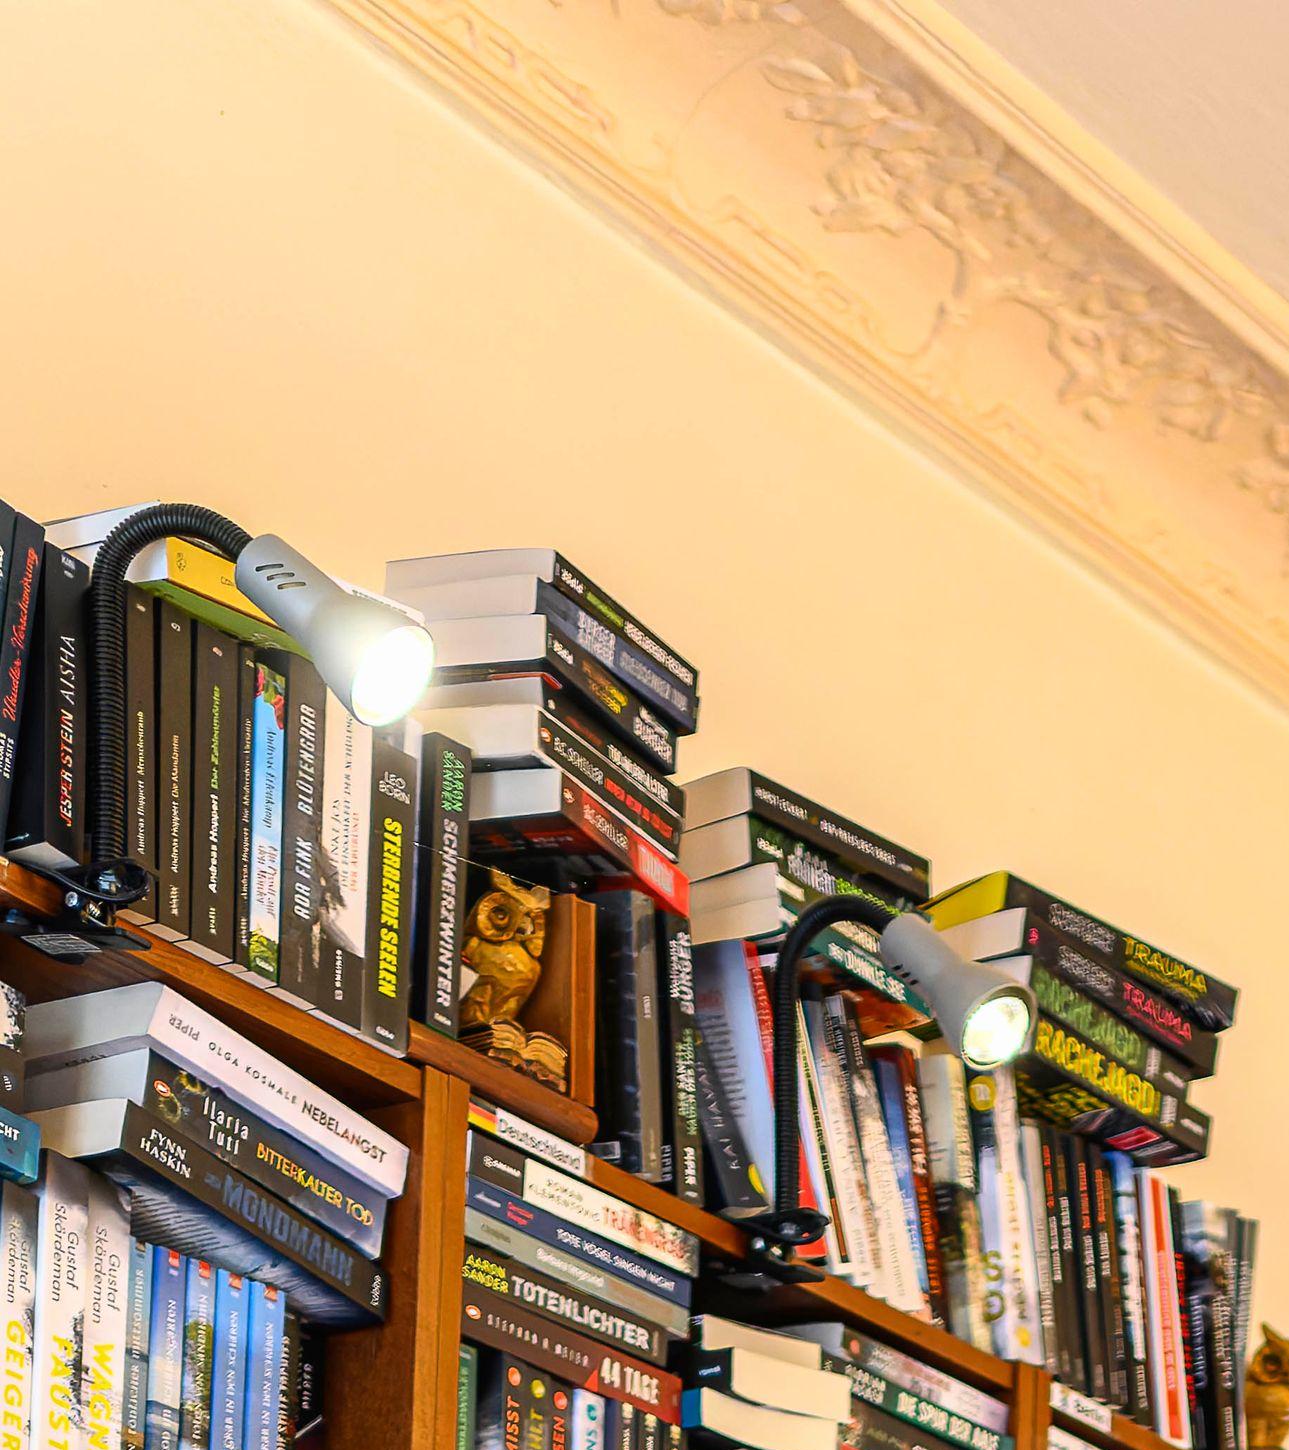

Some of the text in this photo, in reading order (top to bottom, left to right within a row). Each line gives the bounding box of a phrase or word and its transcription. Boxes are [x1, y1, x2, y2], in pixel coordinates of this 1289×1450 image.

[58, 635, 75, 827] JESPER STEIN AISHA
[296, 837, 312, 878] FINK
[378, 817, 402, 998] STERBENDE SEELEN
[436, 817, 457, 1009] SCHMERZWINTER
[208, 1040, 240, 1069] OLGA
[140, 1138, 191, 1178] HASKIN
[150, 1128, 187, 1160] FYNN
[345, 1196, 374, 1228] TOD
[52, 1202, 66, 1302] Skördeman
[66, 1230, 80, 1288] Gustaf
